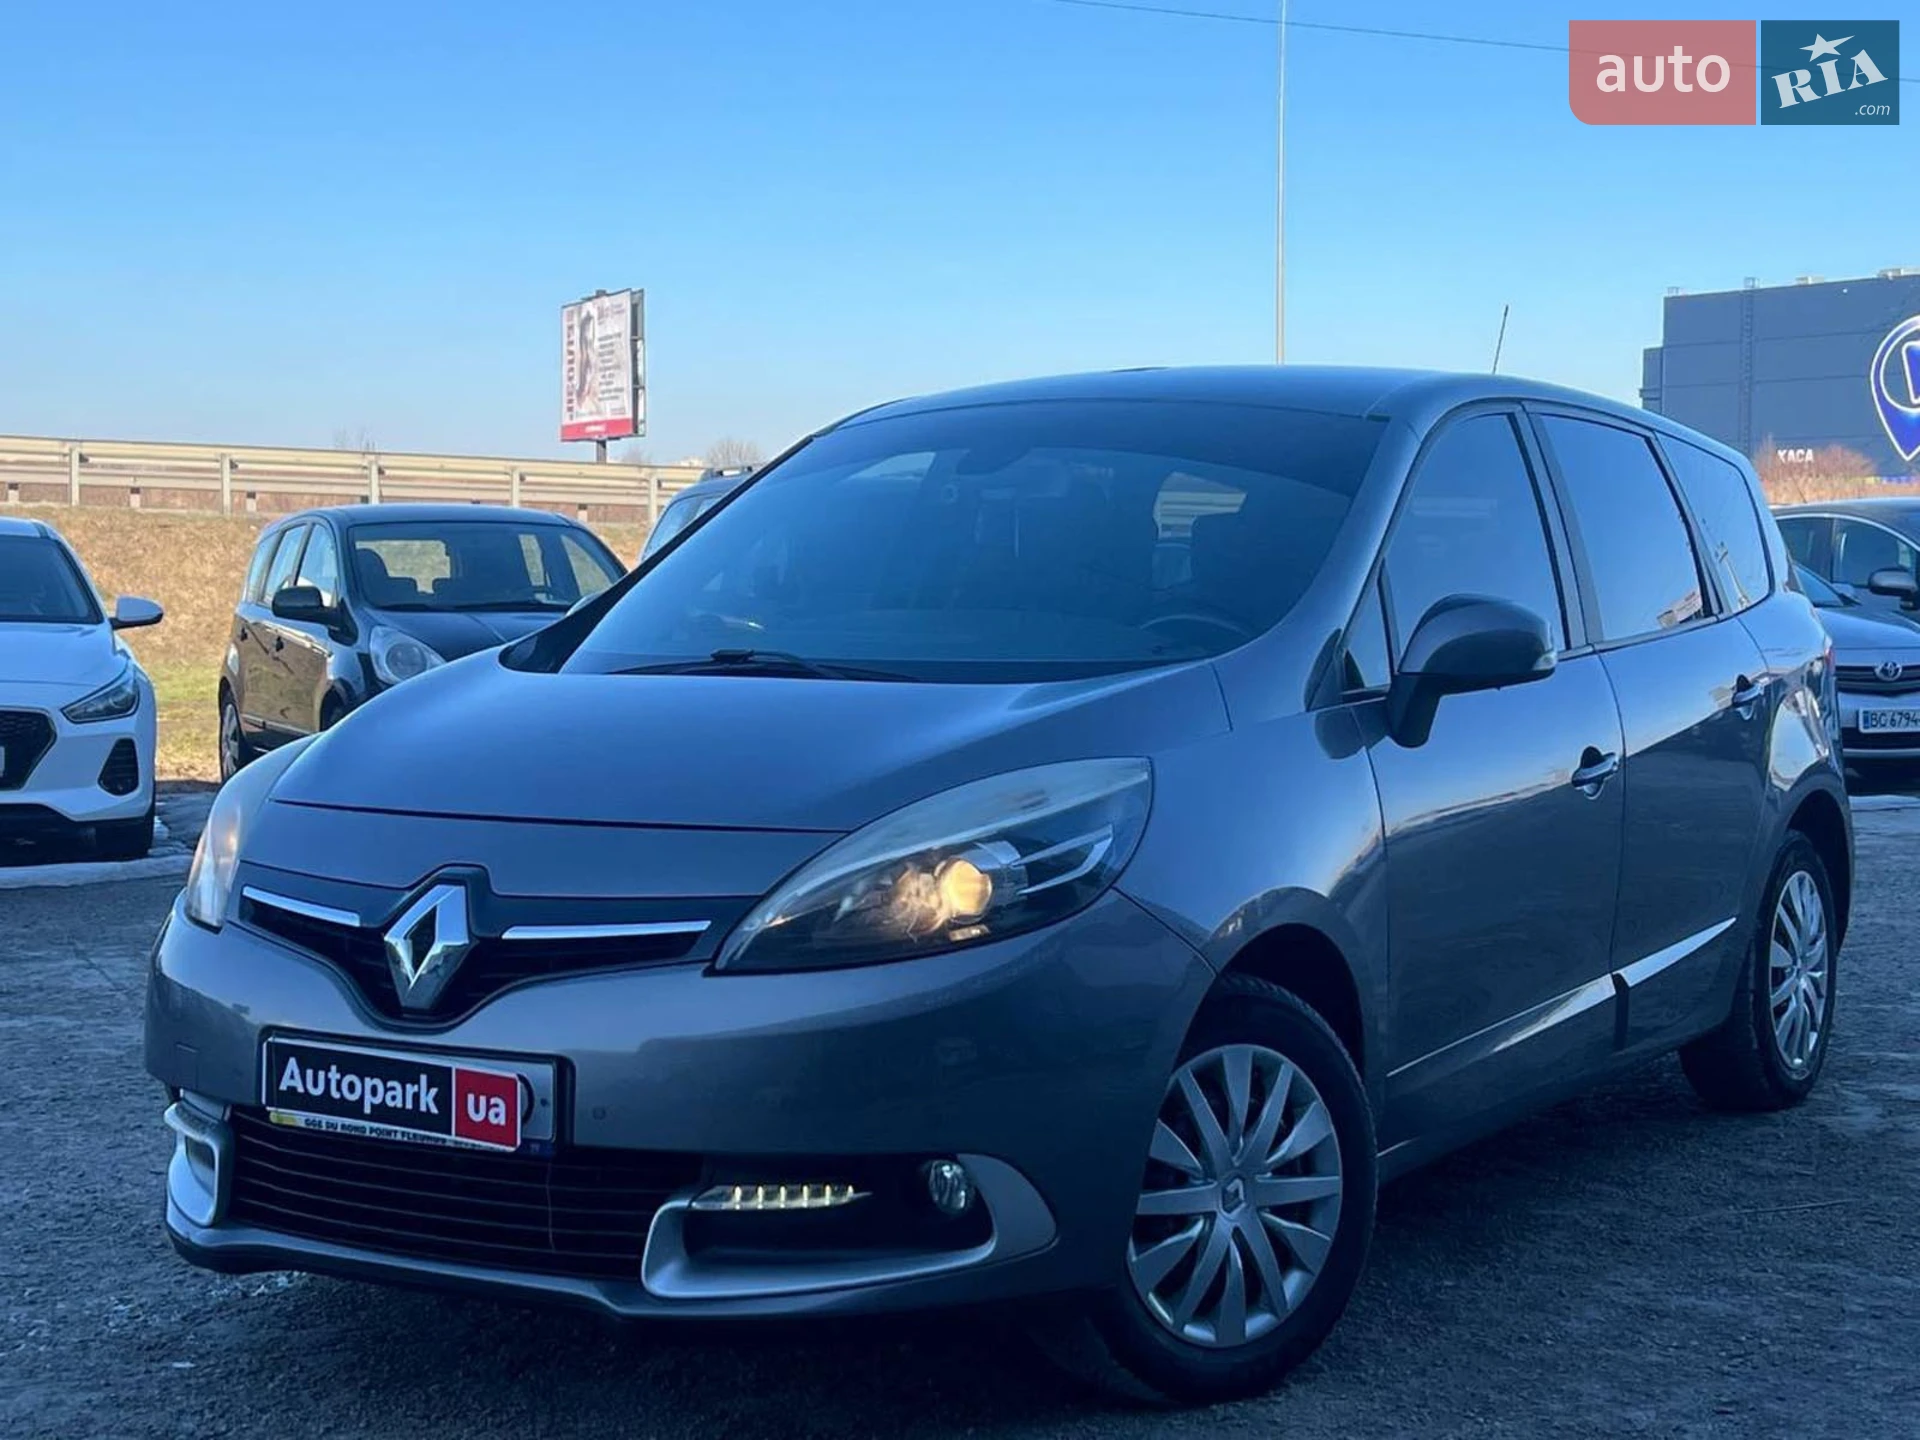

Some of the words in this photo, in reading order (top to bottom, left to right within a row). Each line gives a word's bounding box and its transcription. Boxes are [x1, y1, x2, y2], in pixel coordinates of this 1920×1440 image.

[278, 1056, 439, 1115] Autopark
[466, 1092, 506, 1126] ua
[369, 1126, 399, 1138] POINT
